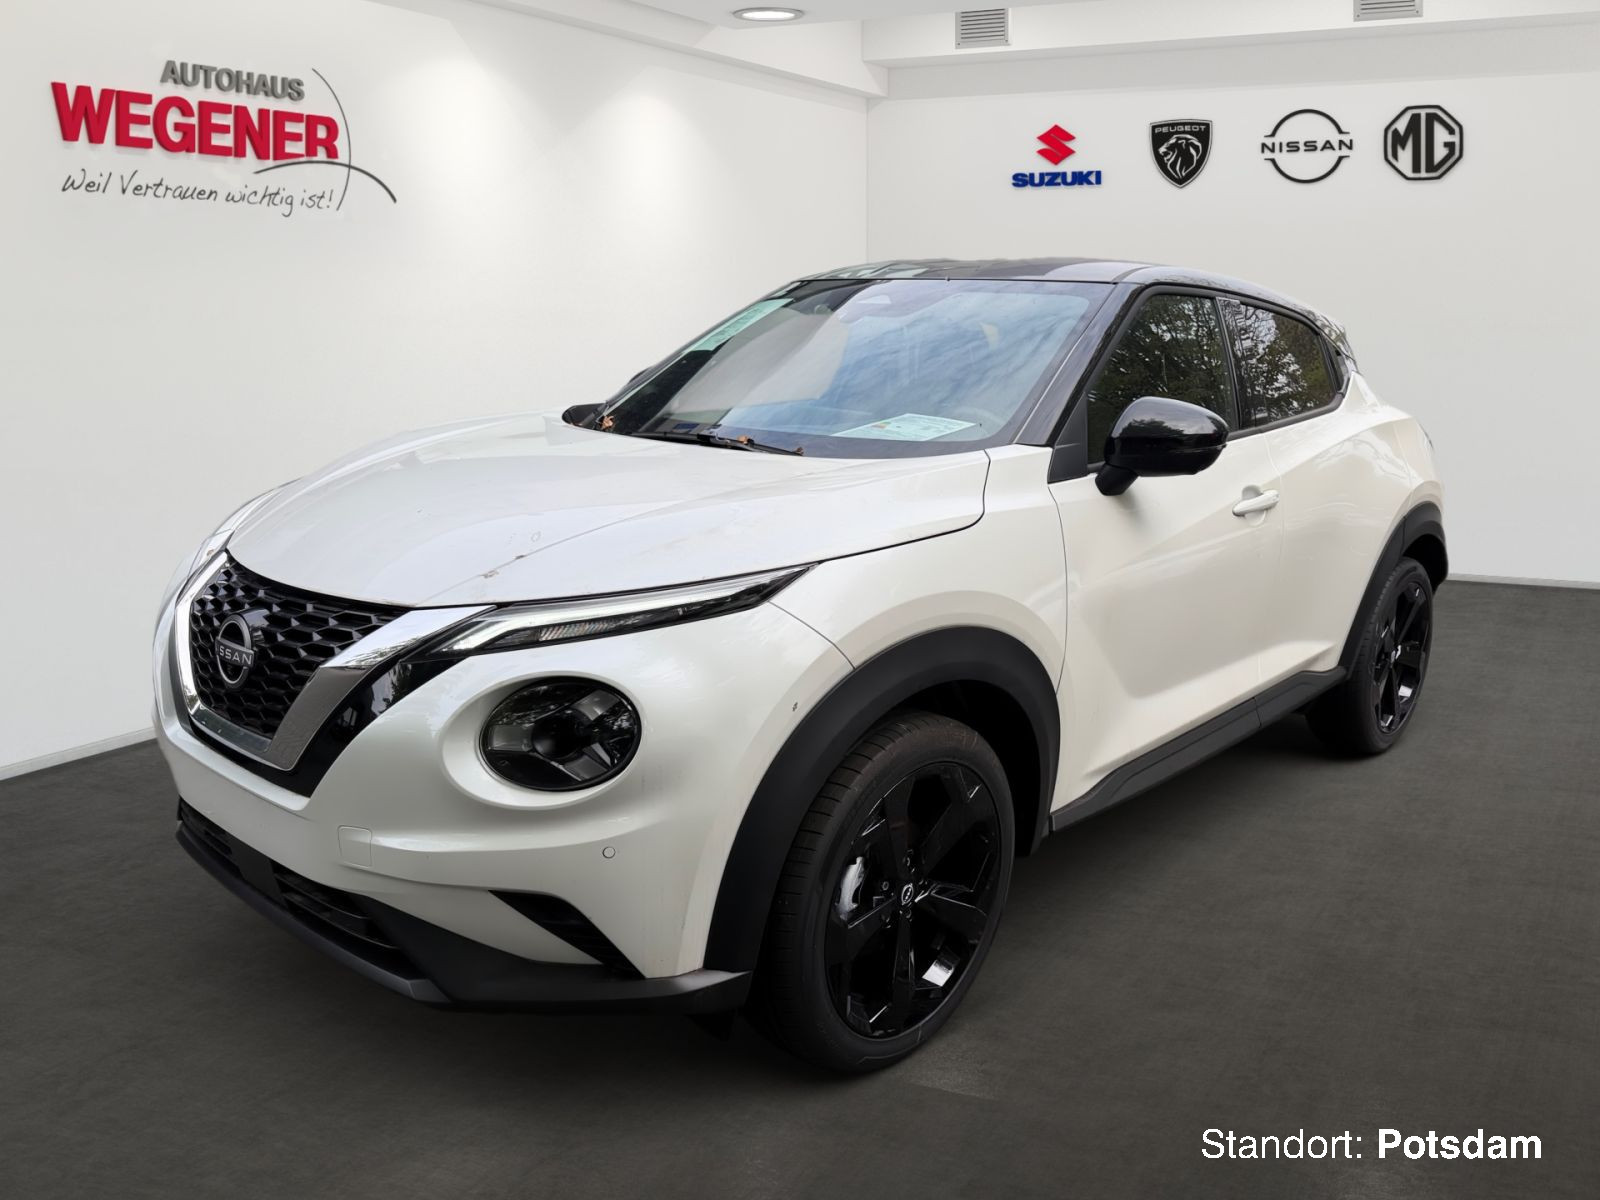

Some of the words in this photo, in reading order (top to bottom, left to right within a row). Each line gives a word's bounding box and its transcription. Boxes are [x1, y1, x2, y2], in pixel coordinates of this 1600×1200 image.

[160, 60, 305, 101] AUTOHAUS
[51, 81, 340, 161] WEGENER
[1154, 125, 1207, 134] PEUGEOT
[1260, 138, 1354, 154] NISSAN
[1391, 112, 1457, 175] MG
[61, 168, 112, 194] Weil
[120, 169, 218, 202] Vertrauen
[225, 184, 294, 218] wichtig
[300, 188, 334, 210] ist!
[1011, 170, 1103, 188] SUZUKI
[216, 643, 252, 666] SSAN
